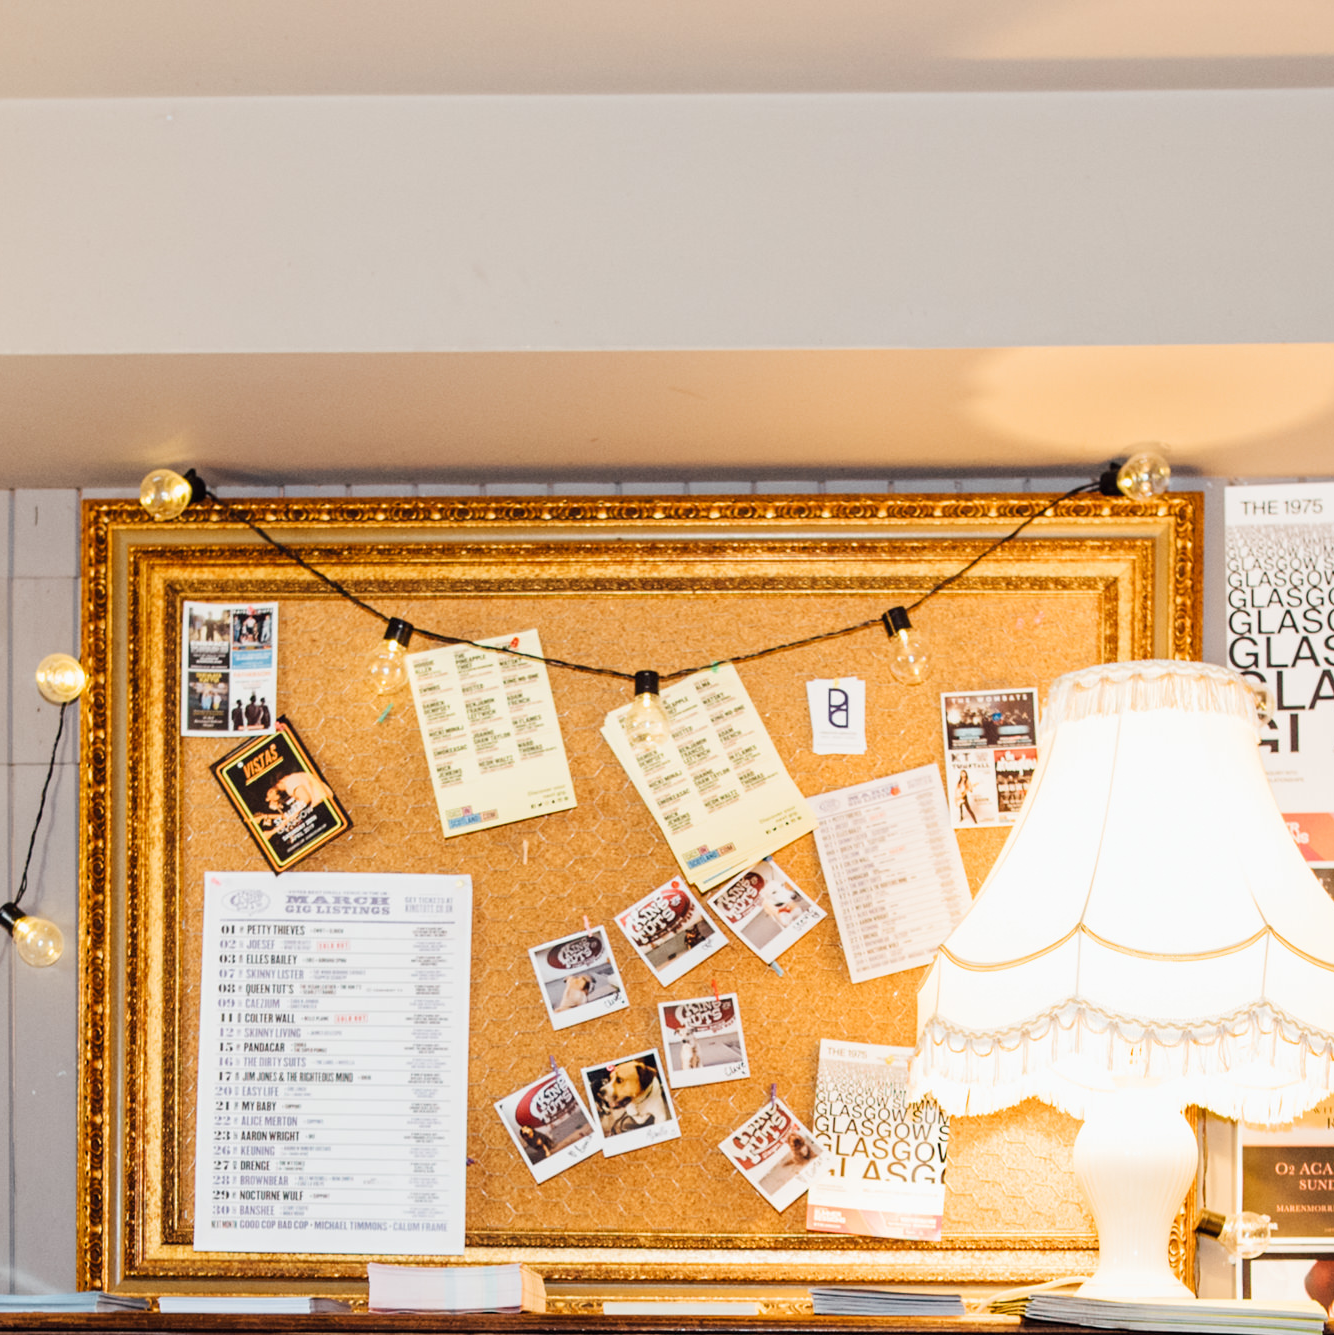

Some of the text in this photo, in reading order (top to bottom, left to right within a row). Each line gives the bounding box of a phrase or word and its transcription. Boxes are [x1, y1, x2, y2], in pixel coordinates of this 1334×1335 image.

[1240, 499, 1323, 515] THE 1975
[243, 744, 279, 779] VISTAS
[285, 896, 390, 905] MARCH
[285, 905, 390, 915] GIG LISTINGS
[247, 925, 272, 935] PETTY
[273, 925, 305, 935] THIEVES
[246, 939, 275, 950] JOESEF
[246, 955, 269, 964] ELLES
[270, 955, 298, 965] BAILEY
[246, 969, 304, 979] SKINNY LISTER
[245, 1013, 296, 1024] COLTER WALL
[244, 1043, 285, 1052] PANDACAR
[242, 1072, 256, 1082] JIM
[257, 1072, 277, 1082] JONES
[279, 1073, 285, 1082] &
[286, 1073, 297, 1082] THE
[299, 1073, 335, 1082] RIGHTEOUS
[336, 1073, 353, 1082] MIND
[242, 1101, 277, 1111] MY BABY
[240, 1131, 299, 1141] AARON WRIGHT
[240, 1176, 289, 1186] BROWNBEAR
[240, 1190, 303, 1201] NOCTURNE WULF
[240, 1205, 274, 1216] BANSHEE
